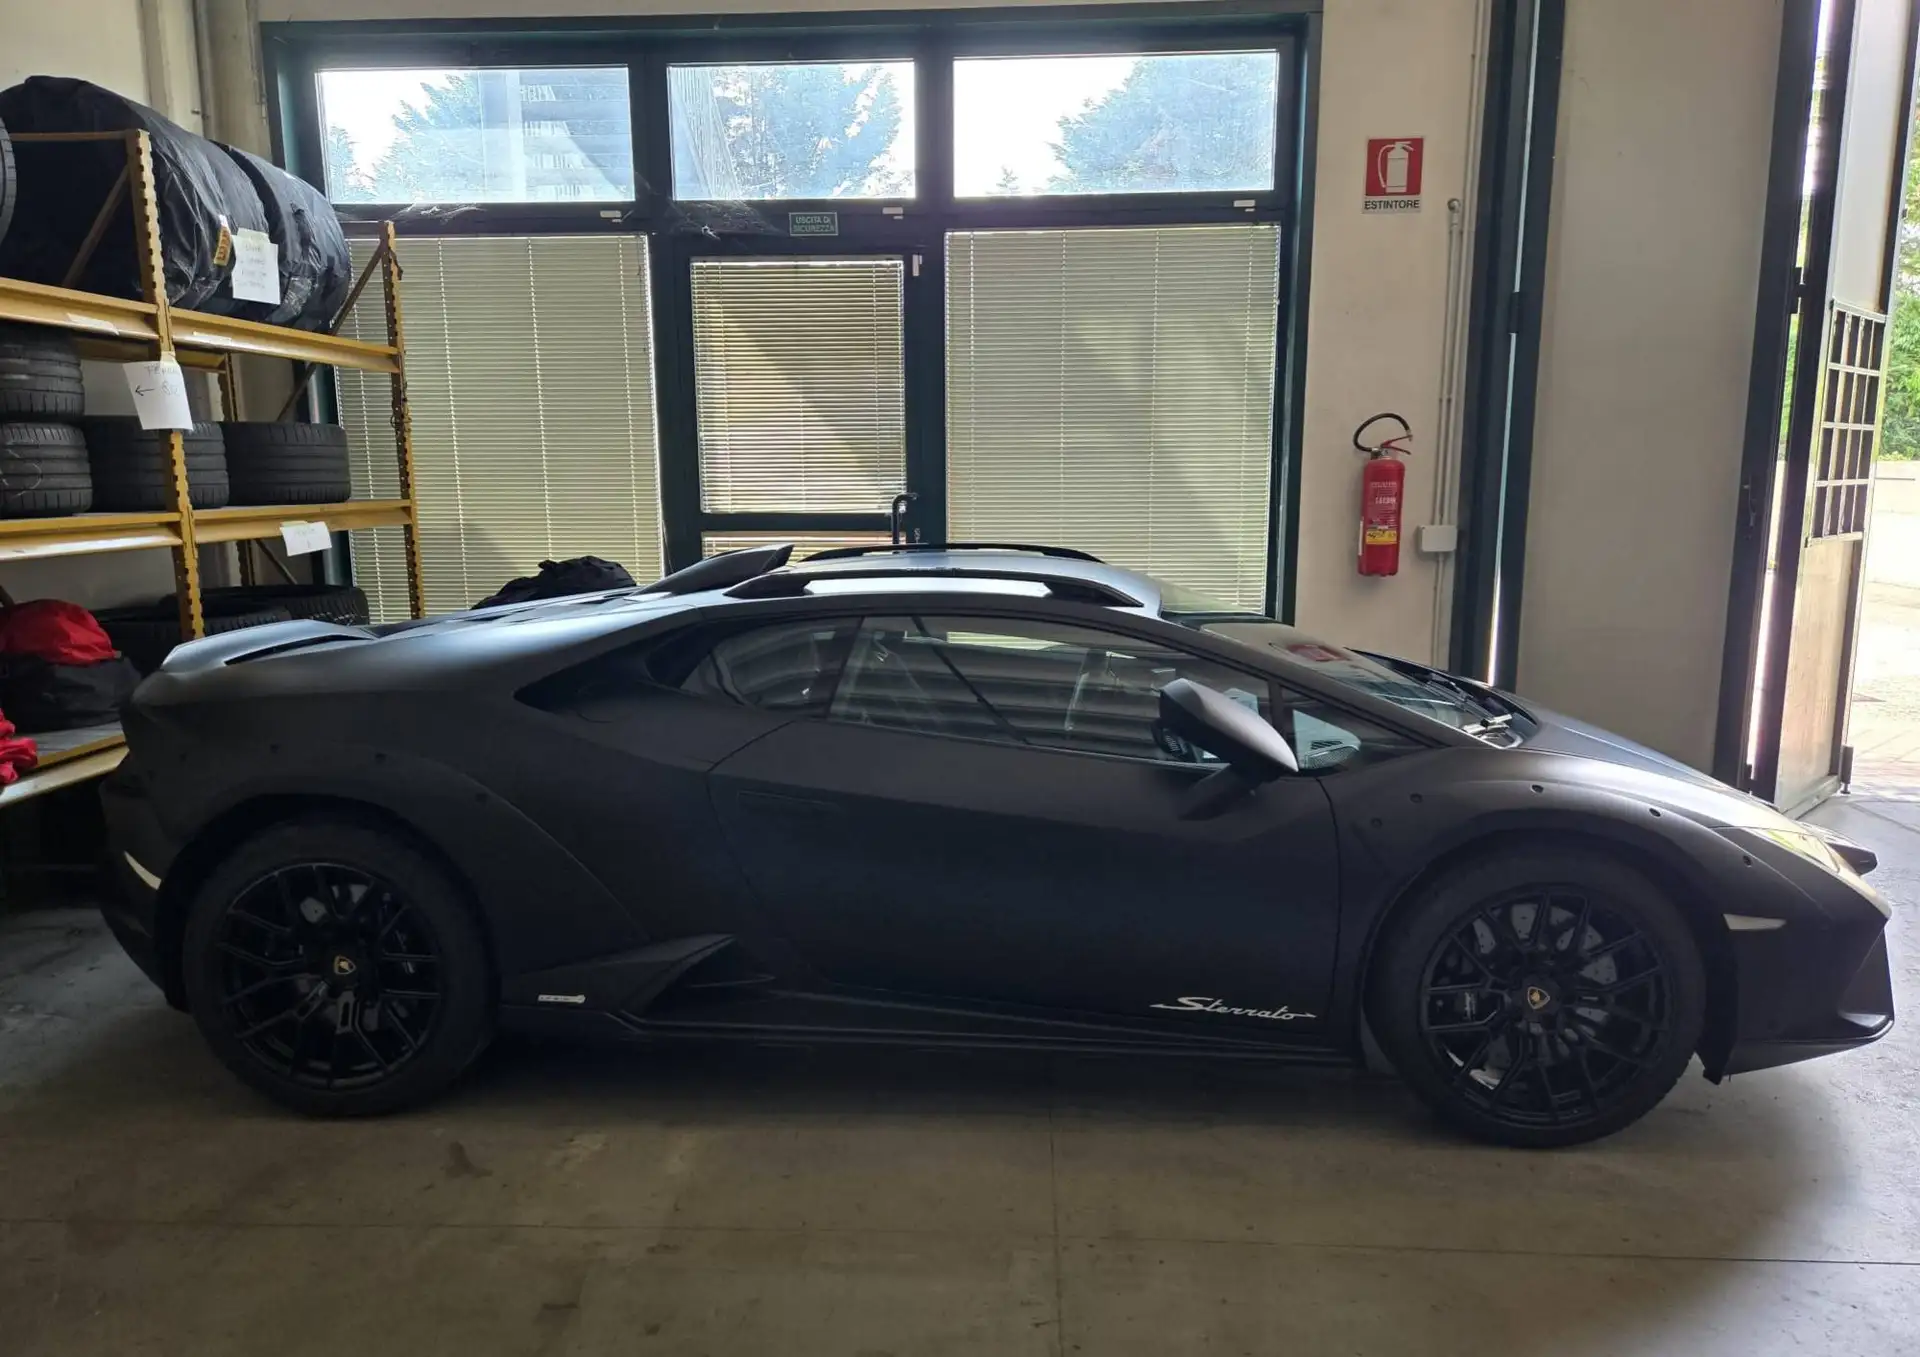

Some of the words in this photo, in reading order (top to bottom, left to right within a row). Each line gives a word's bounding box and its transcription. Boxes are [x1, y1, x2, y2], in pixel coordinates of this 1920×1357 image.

[1364, 199, 1420, 210] ESTINTORE
[795, 216, 822, 224] USCITA
[1150, 996, 1317, 1020] Sterrato
